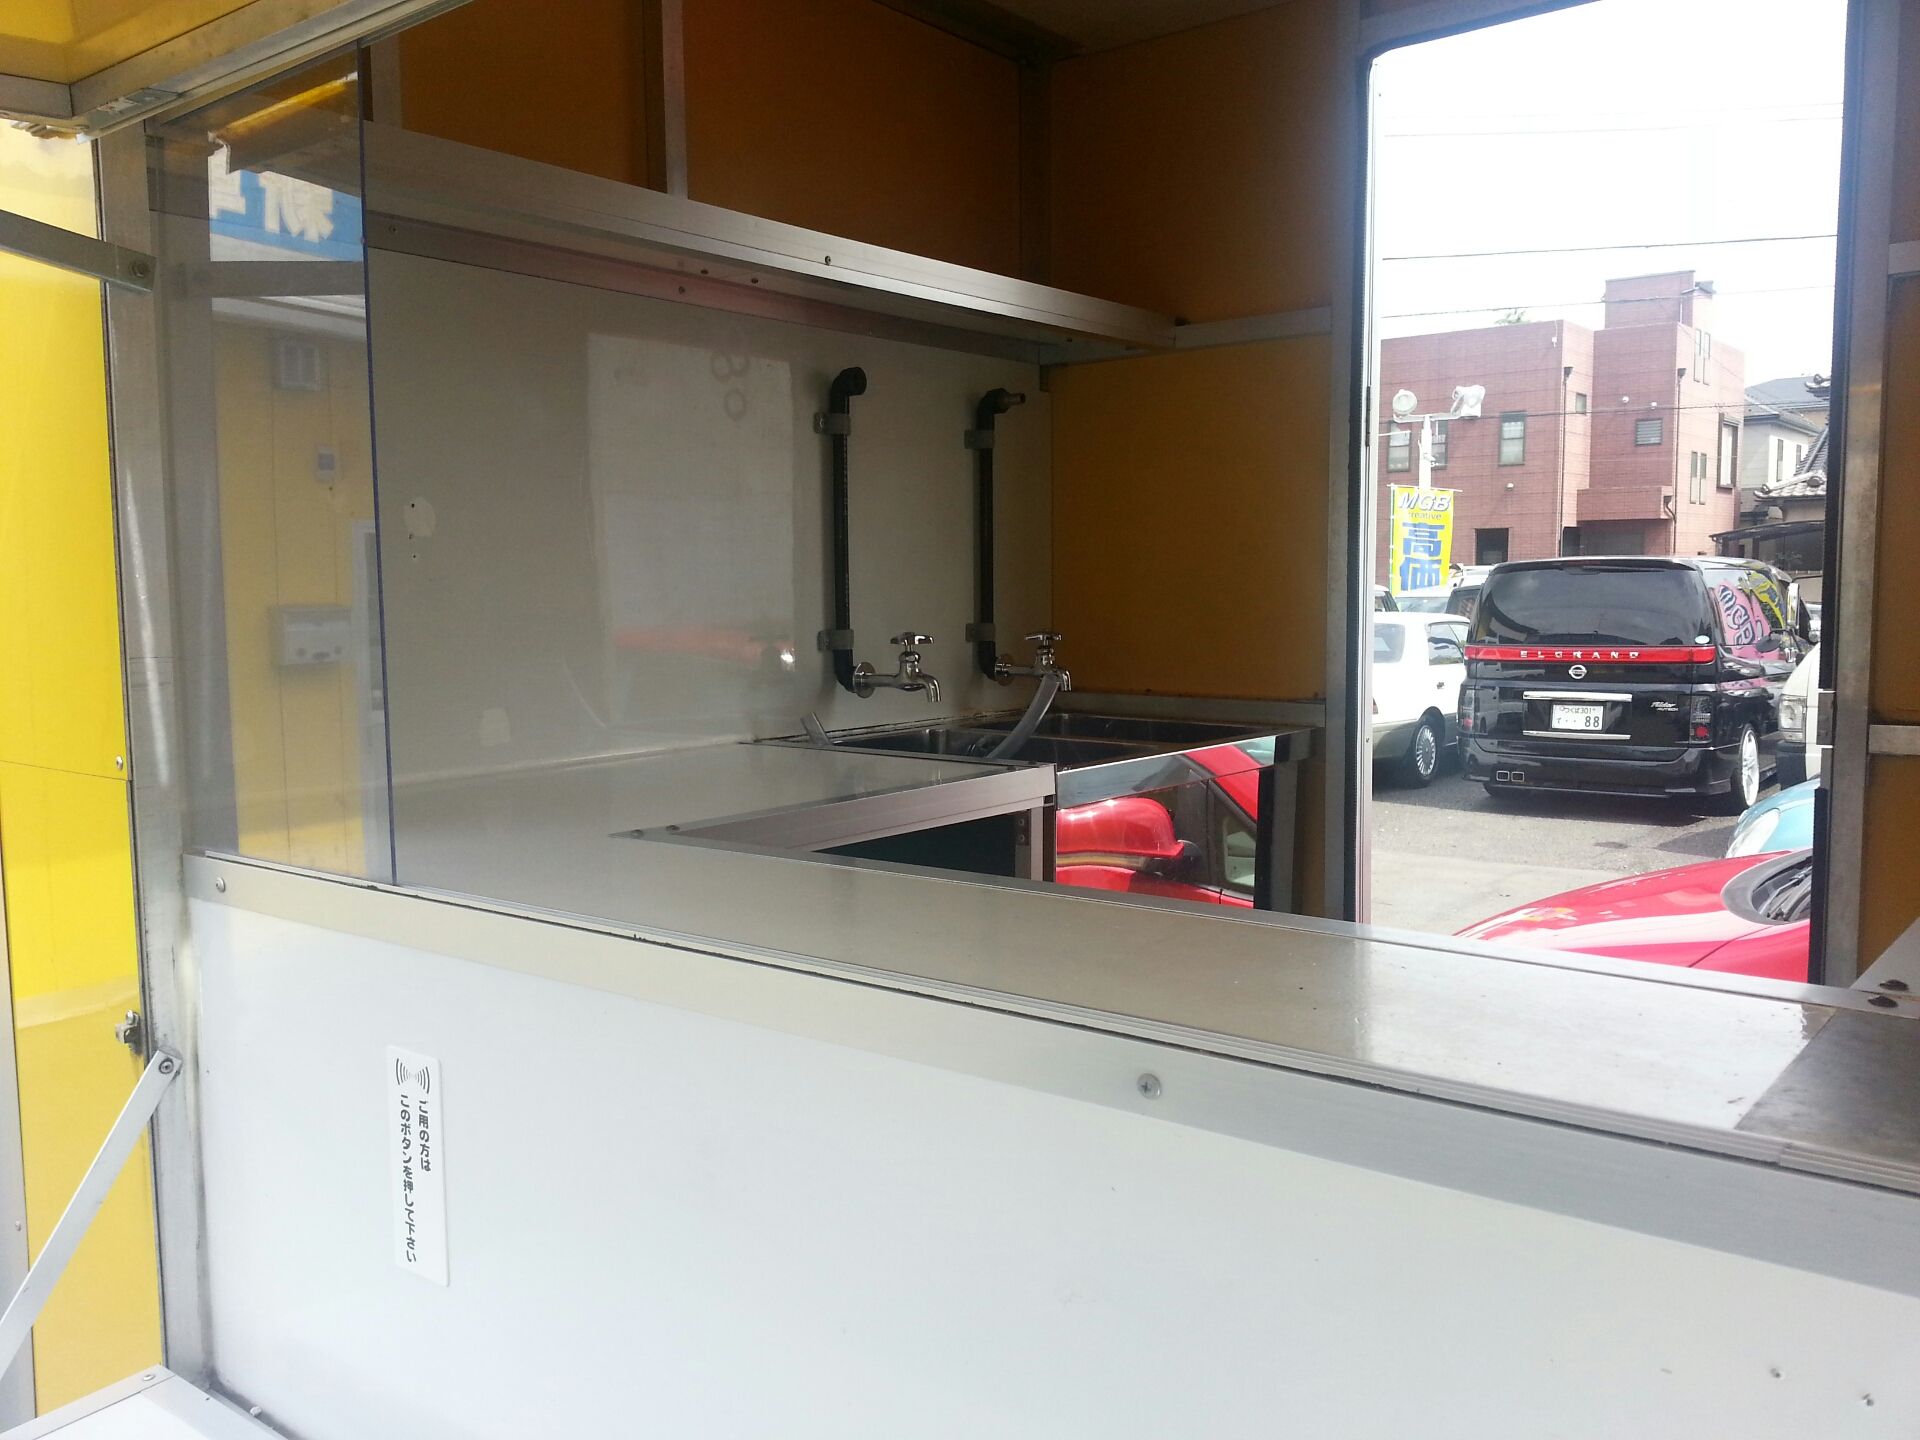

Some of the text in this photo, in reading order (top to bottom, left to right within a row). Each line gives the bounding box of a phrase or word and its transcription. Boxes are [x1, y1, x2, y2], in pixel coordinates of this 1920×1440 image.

[1399, 491, 1452, 512] MGB
[1400, 522, 1446, 592] 高価
[1520, 650, 1639, 658] ELGRAND
[1584, 715, 1600, 728] 88
[418, 1100, 431, 1172] ご用の方は
[400, 1095, 417, 1263] このボタンを押して下さい
